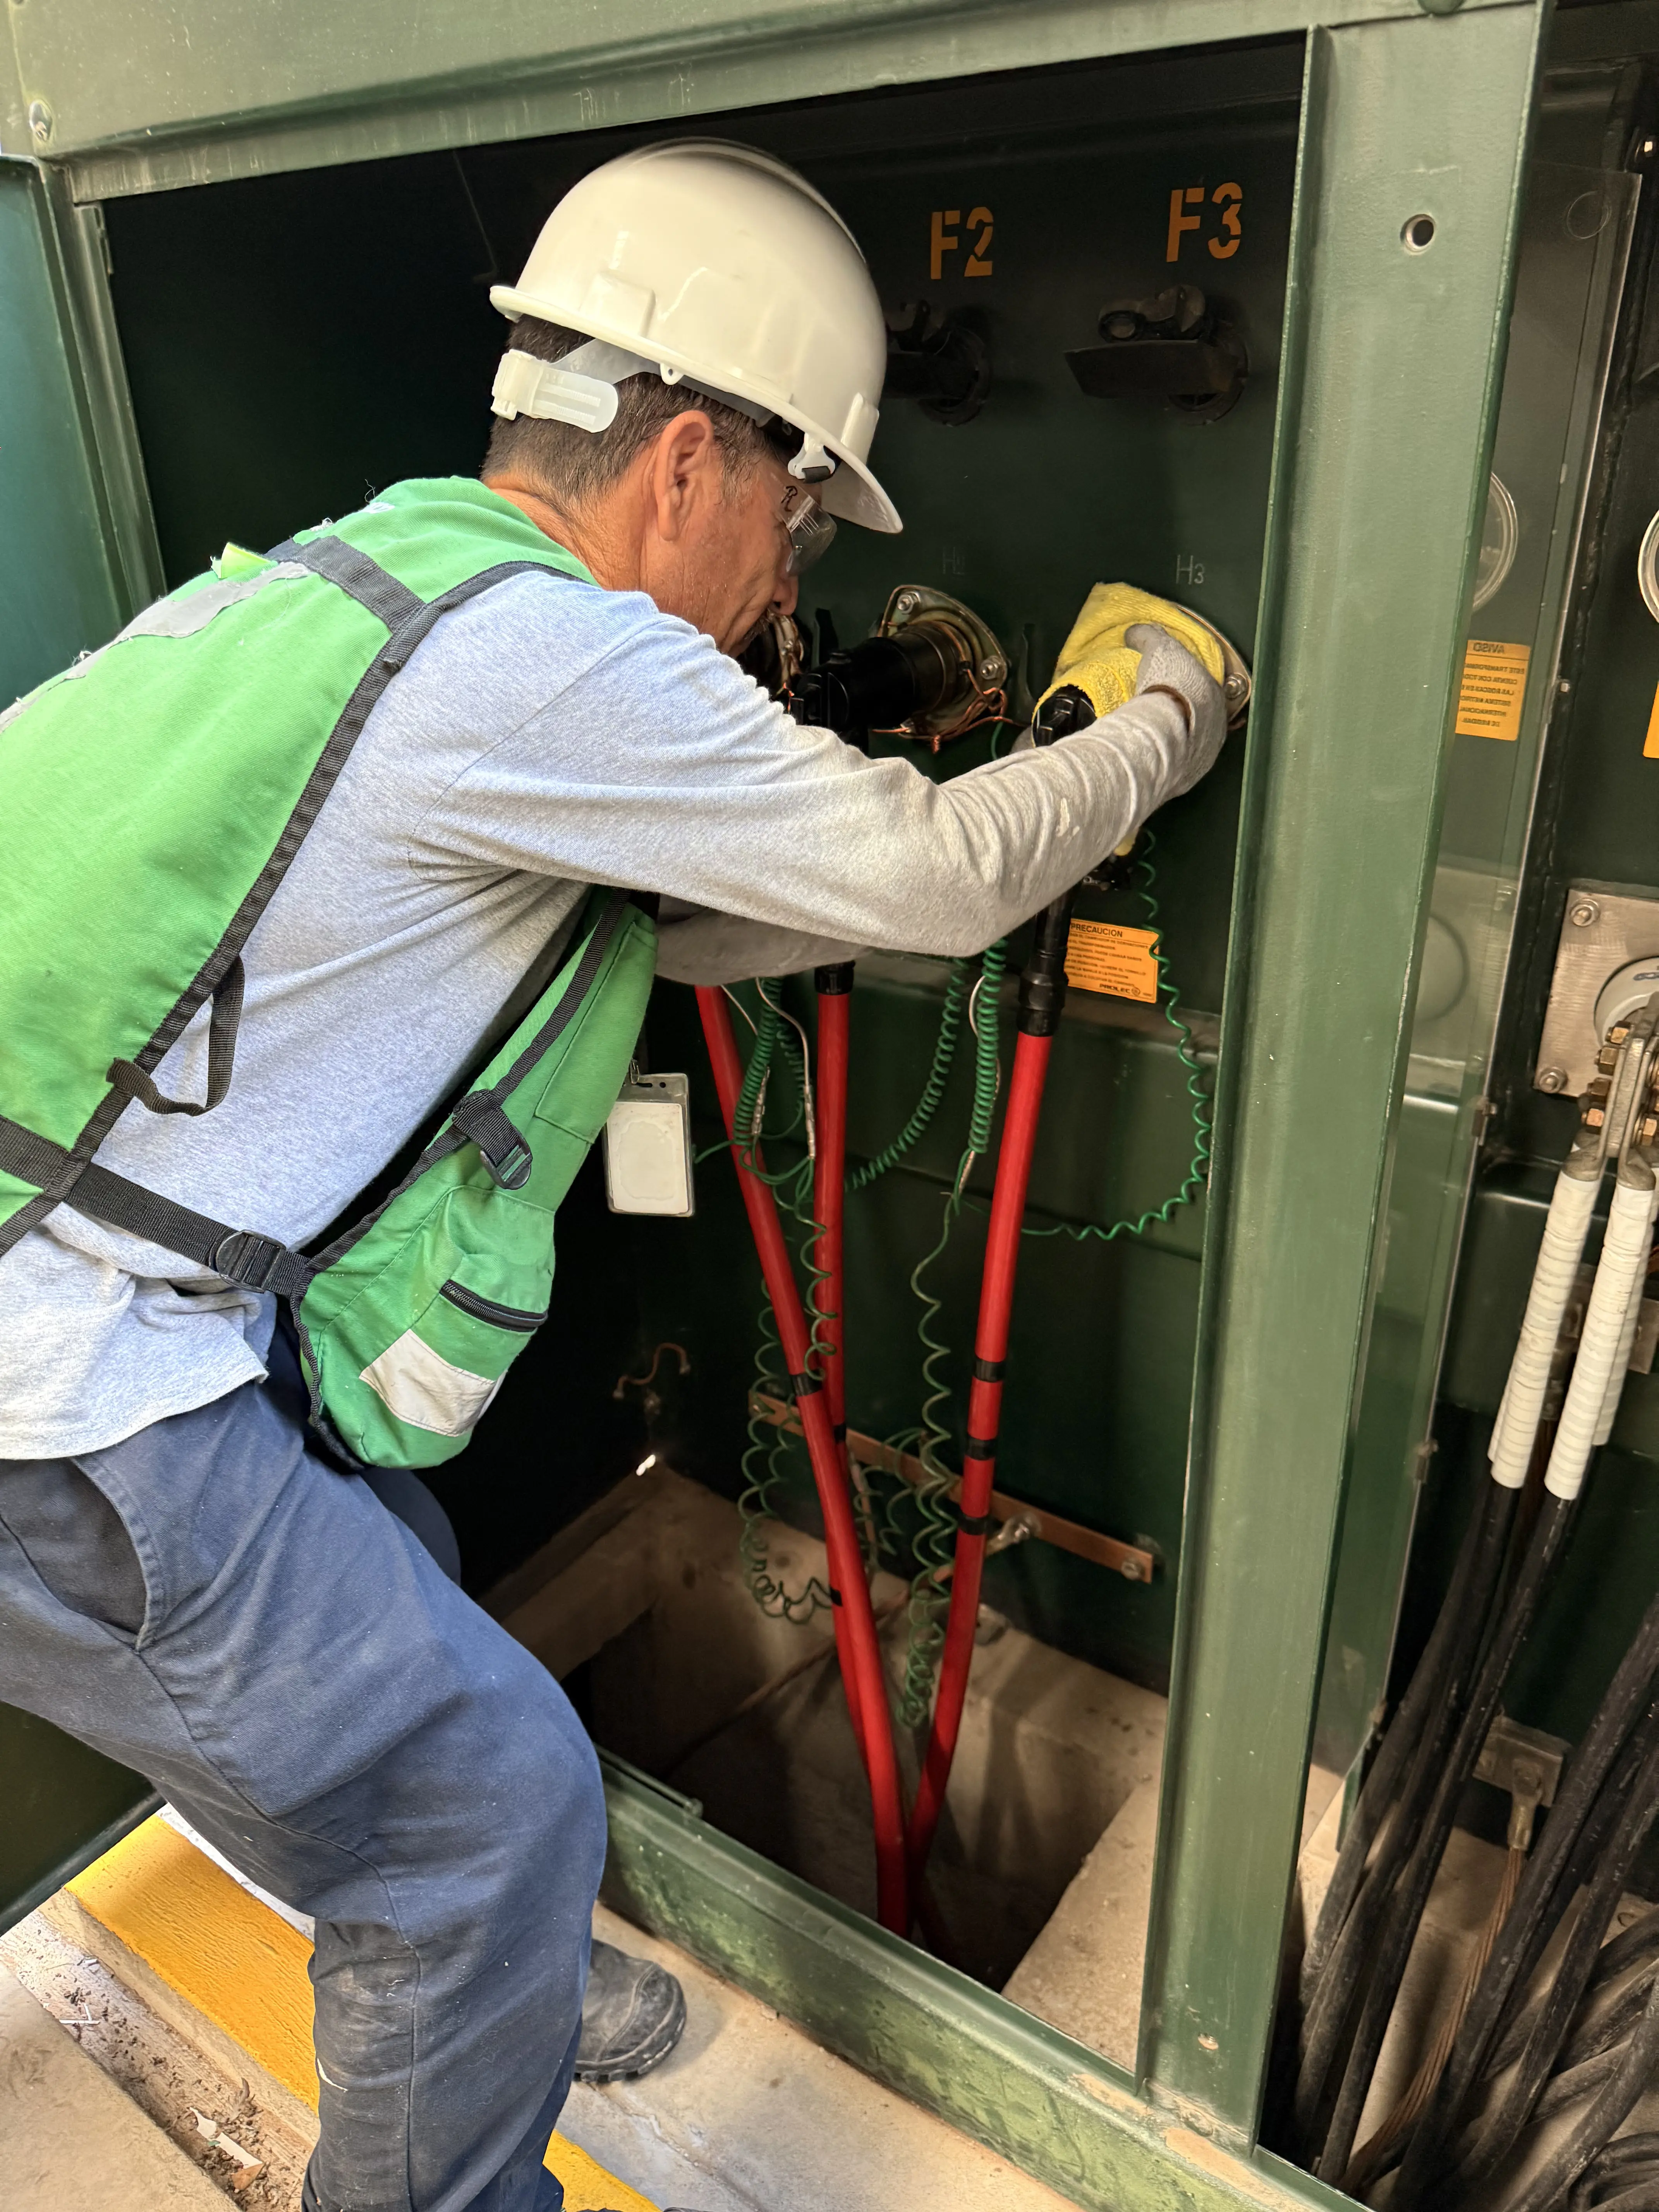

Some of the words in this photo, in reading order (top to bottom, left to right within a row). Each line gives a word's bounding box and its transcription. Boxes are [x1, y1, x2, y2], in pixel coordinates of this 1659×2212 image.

[931, 206, 994, 280] F2
[1166, 182, 1243, 262] F3
[1176, 554, 1205, 586] H3
[1070, 923, 1123, 938] PRECAUCION
